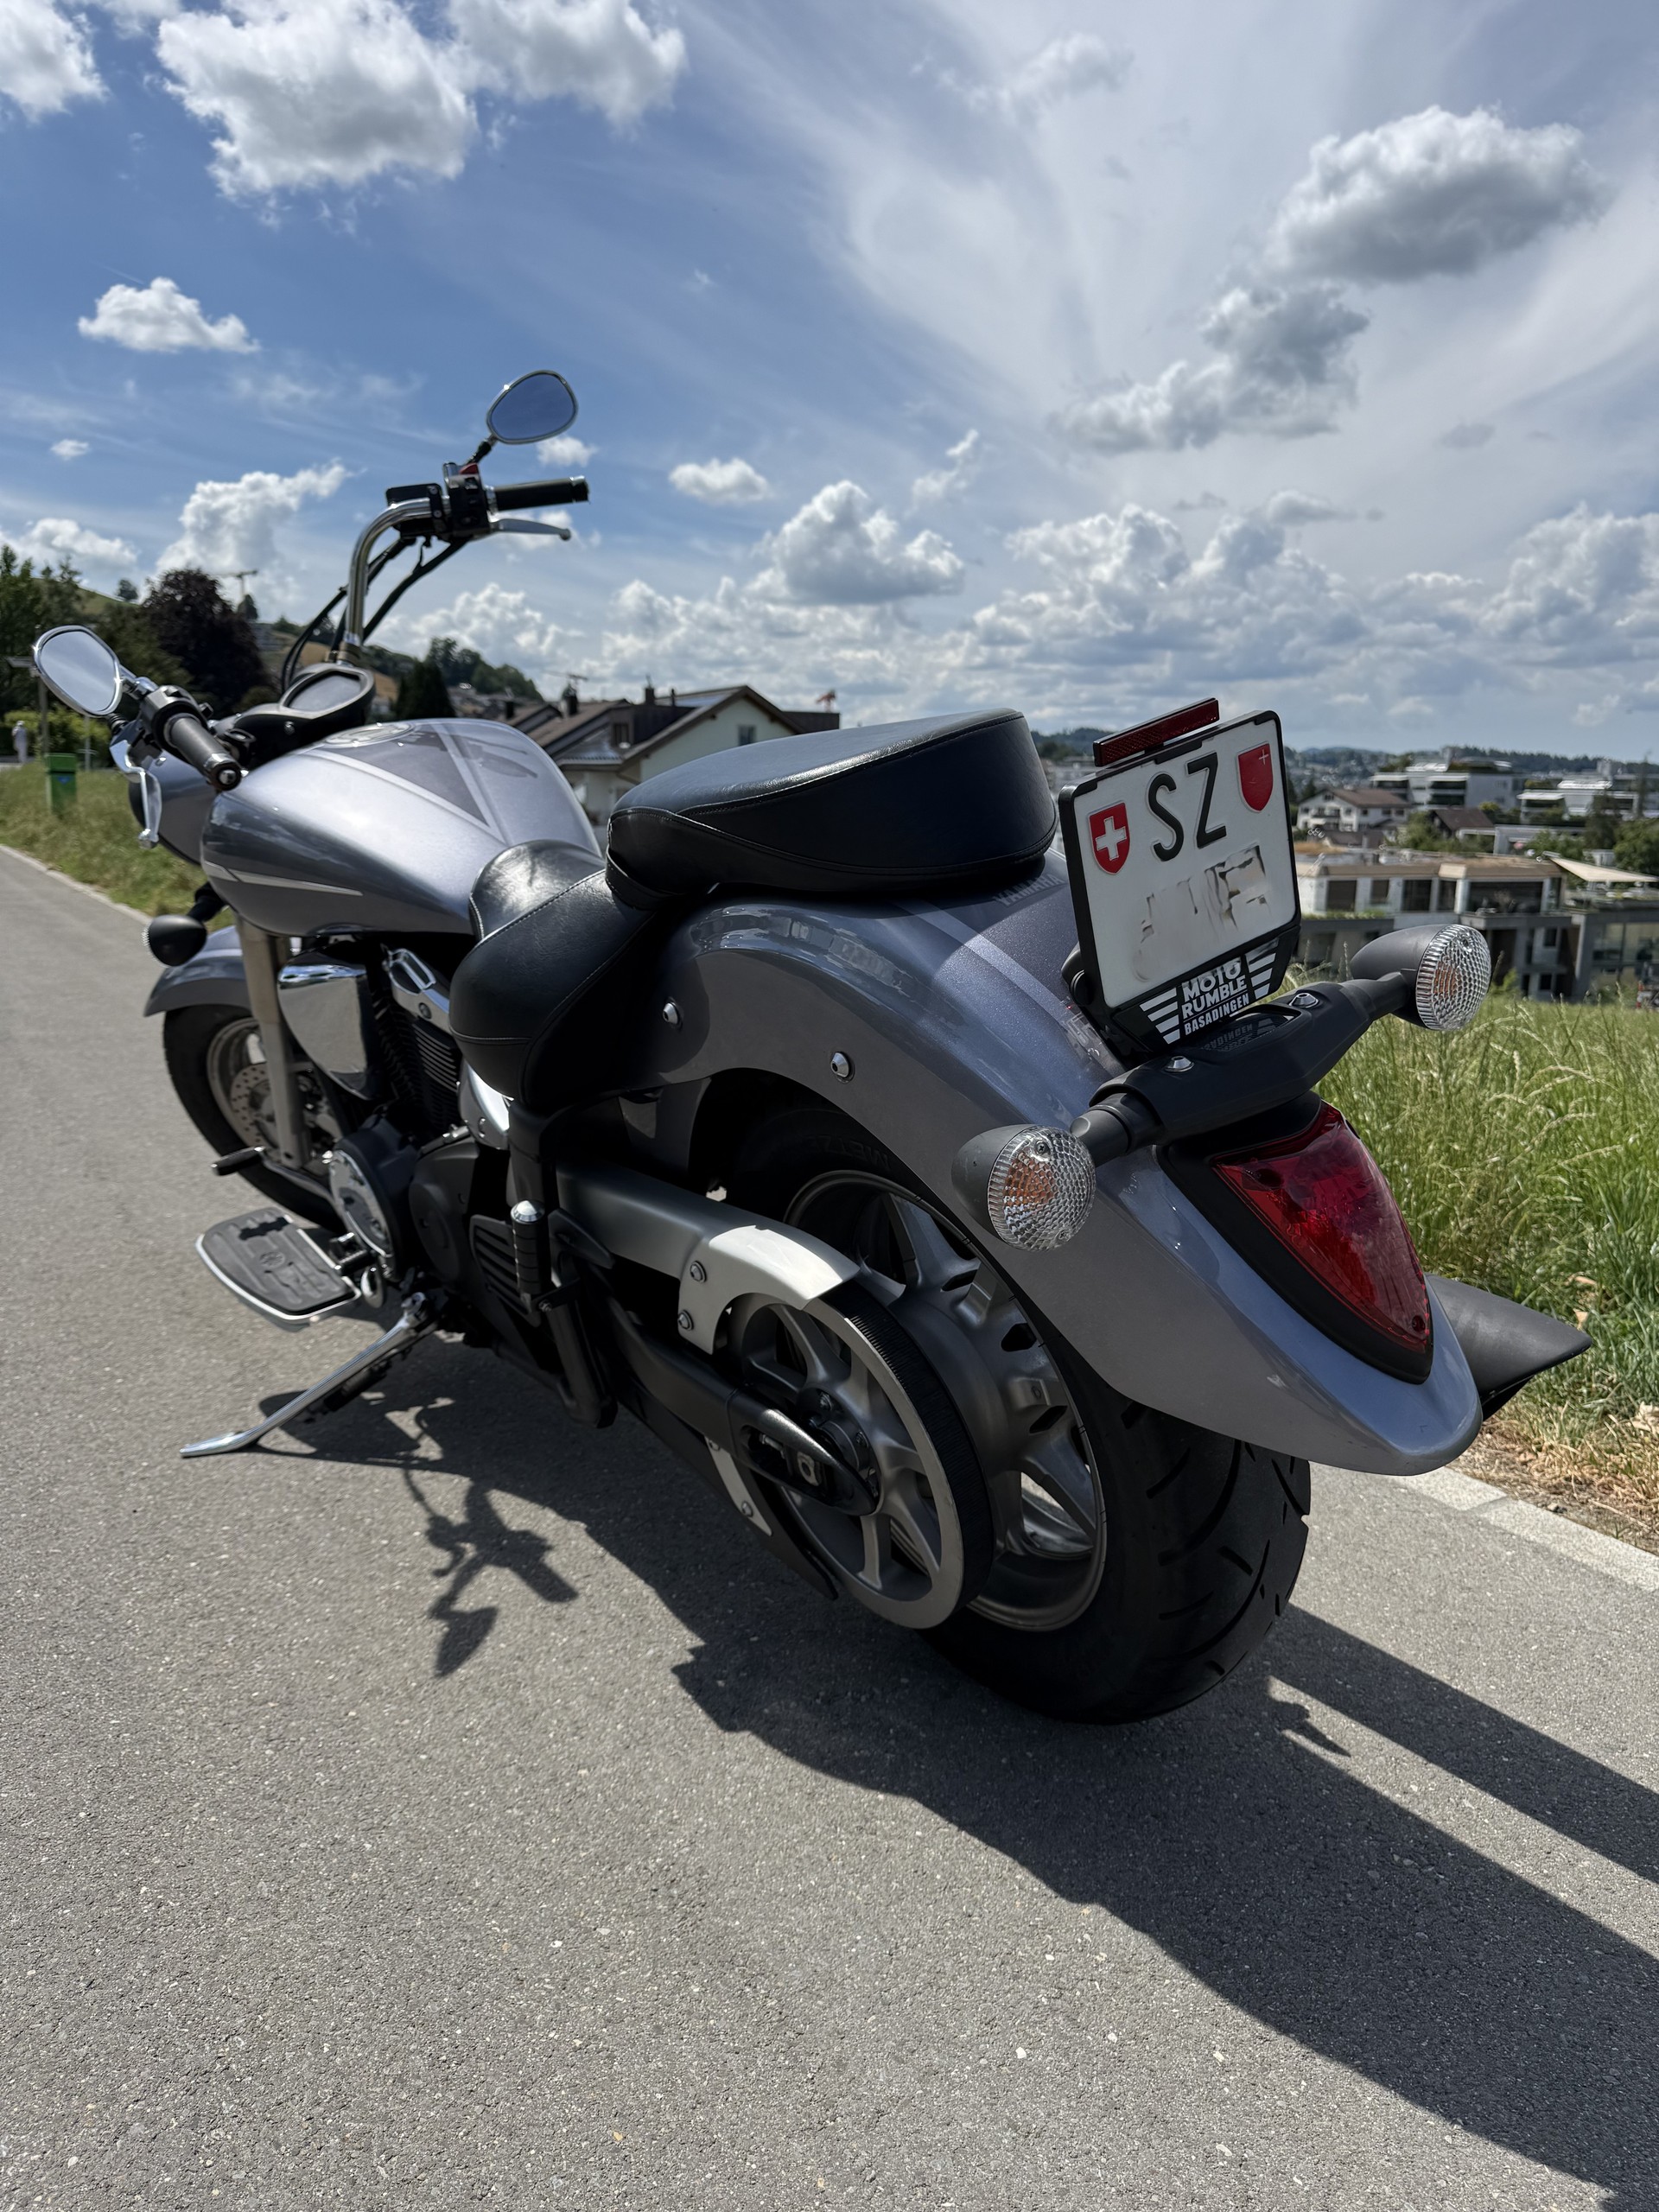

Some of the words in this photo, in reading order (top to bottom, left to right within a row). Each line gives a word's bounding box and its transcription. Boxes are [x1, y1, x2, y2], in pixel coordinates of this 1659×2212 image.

[1149, 752, 1227, 861] SZ
[992, 874, 1067, 906] YAMAHA
[1182, 957, 1242, 1002] MOTO
[1182, 975, 1248, 1019] RUMBLE
[1184, 993, 1249, 1035] BASADINGEN
